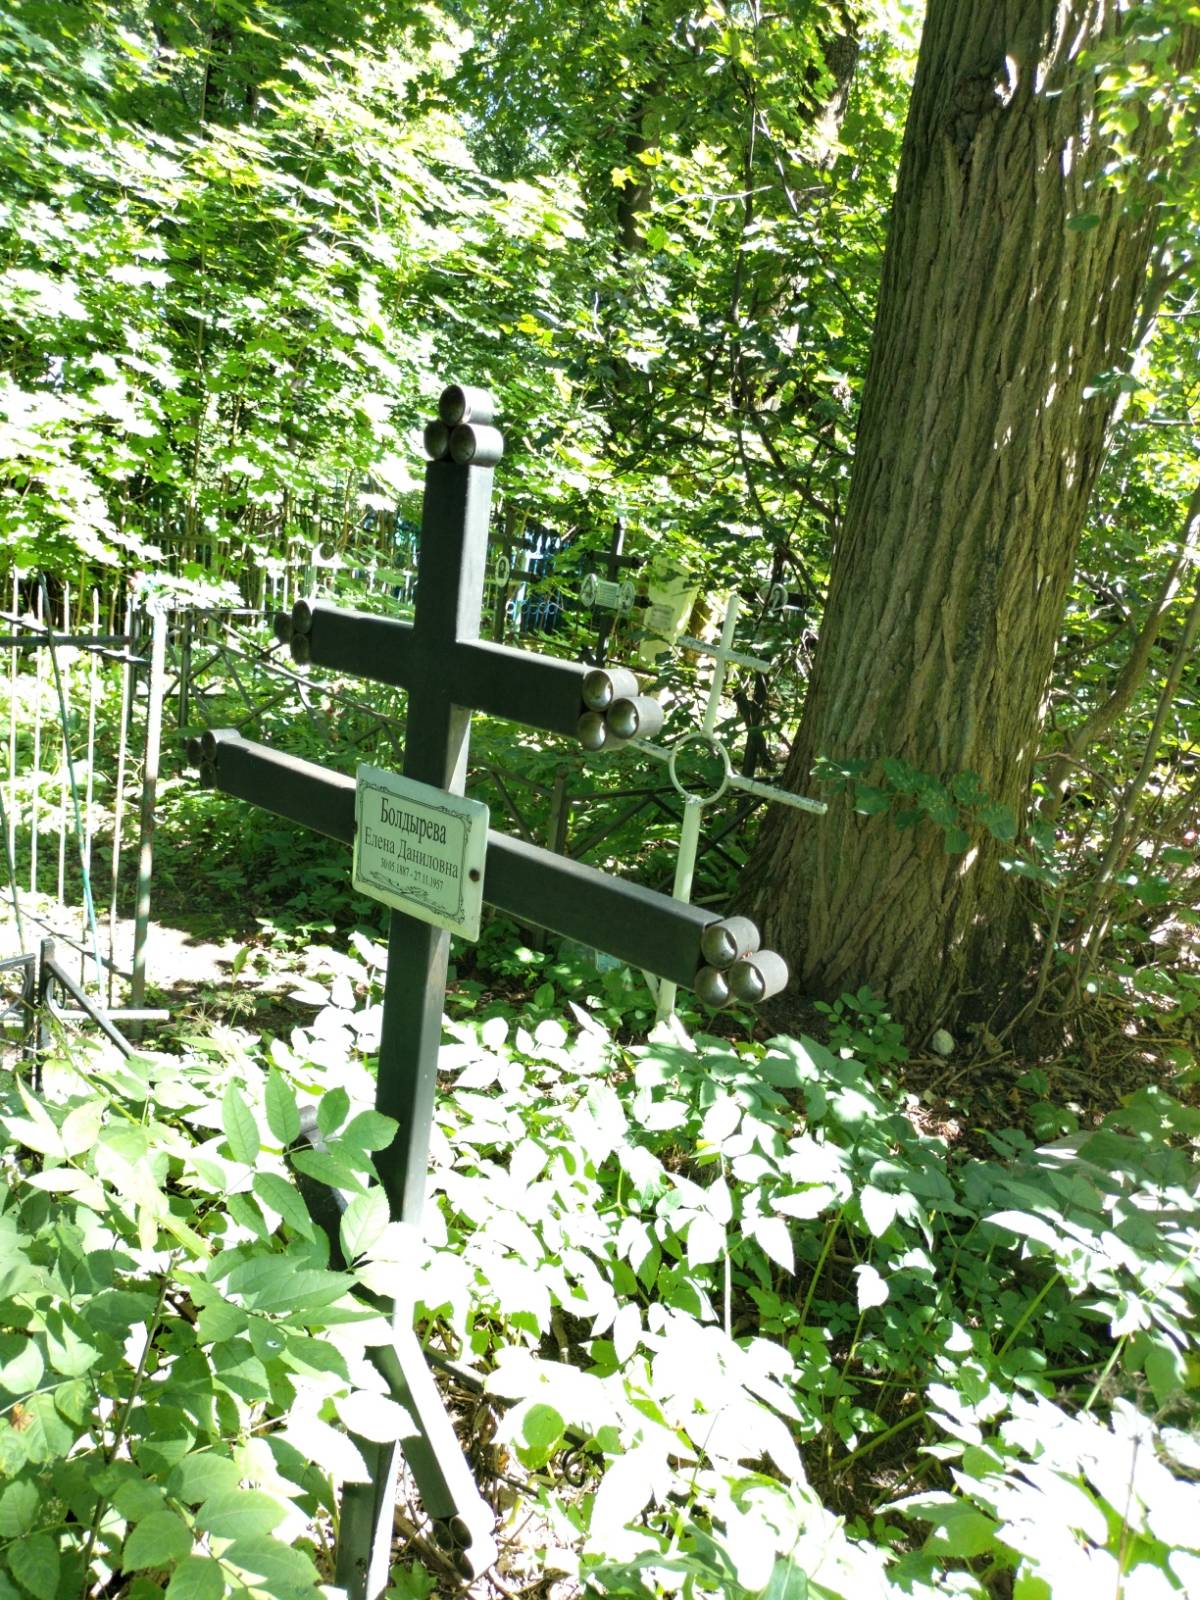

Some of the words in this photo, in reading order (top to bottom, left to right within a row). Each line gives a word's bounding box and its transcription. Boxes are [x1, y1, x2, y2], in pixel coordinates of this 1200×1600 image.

[380, 797, 447, 845] Болдырева
[364, 826, 395, 855] Елена
[397, 839, 458, 879] Даниловна
